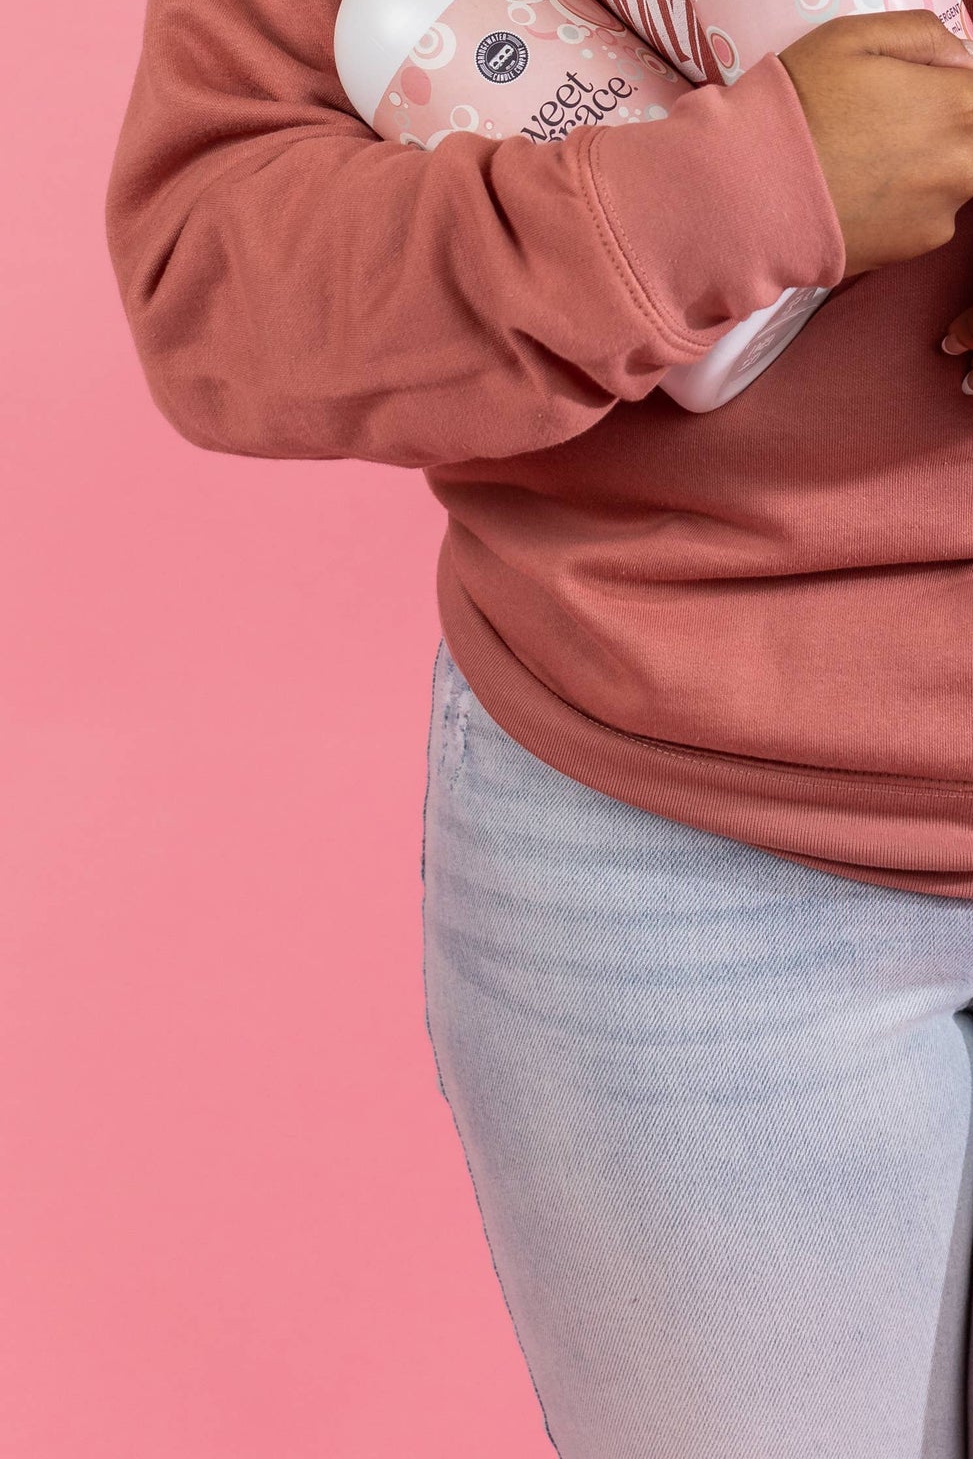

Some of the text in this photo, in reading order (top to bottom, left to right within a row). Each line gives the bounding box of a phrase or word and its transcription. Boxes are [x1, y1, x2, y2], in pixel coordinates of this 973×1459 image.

[939, 2, 962, 24] ERGENT
[477, 33, 507, 64] BRIDGEWATER
[492, 71, 515, 81] CANDLE
[513, 46, 527, 74] COMPANY
[520, 71, 594, 145] weet
[548, 77, 633, 143] race
